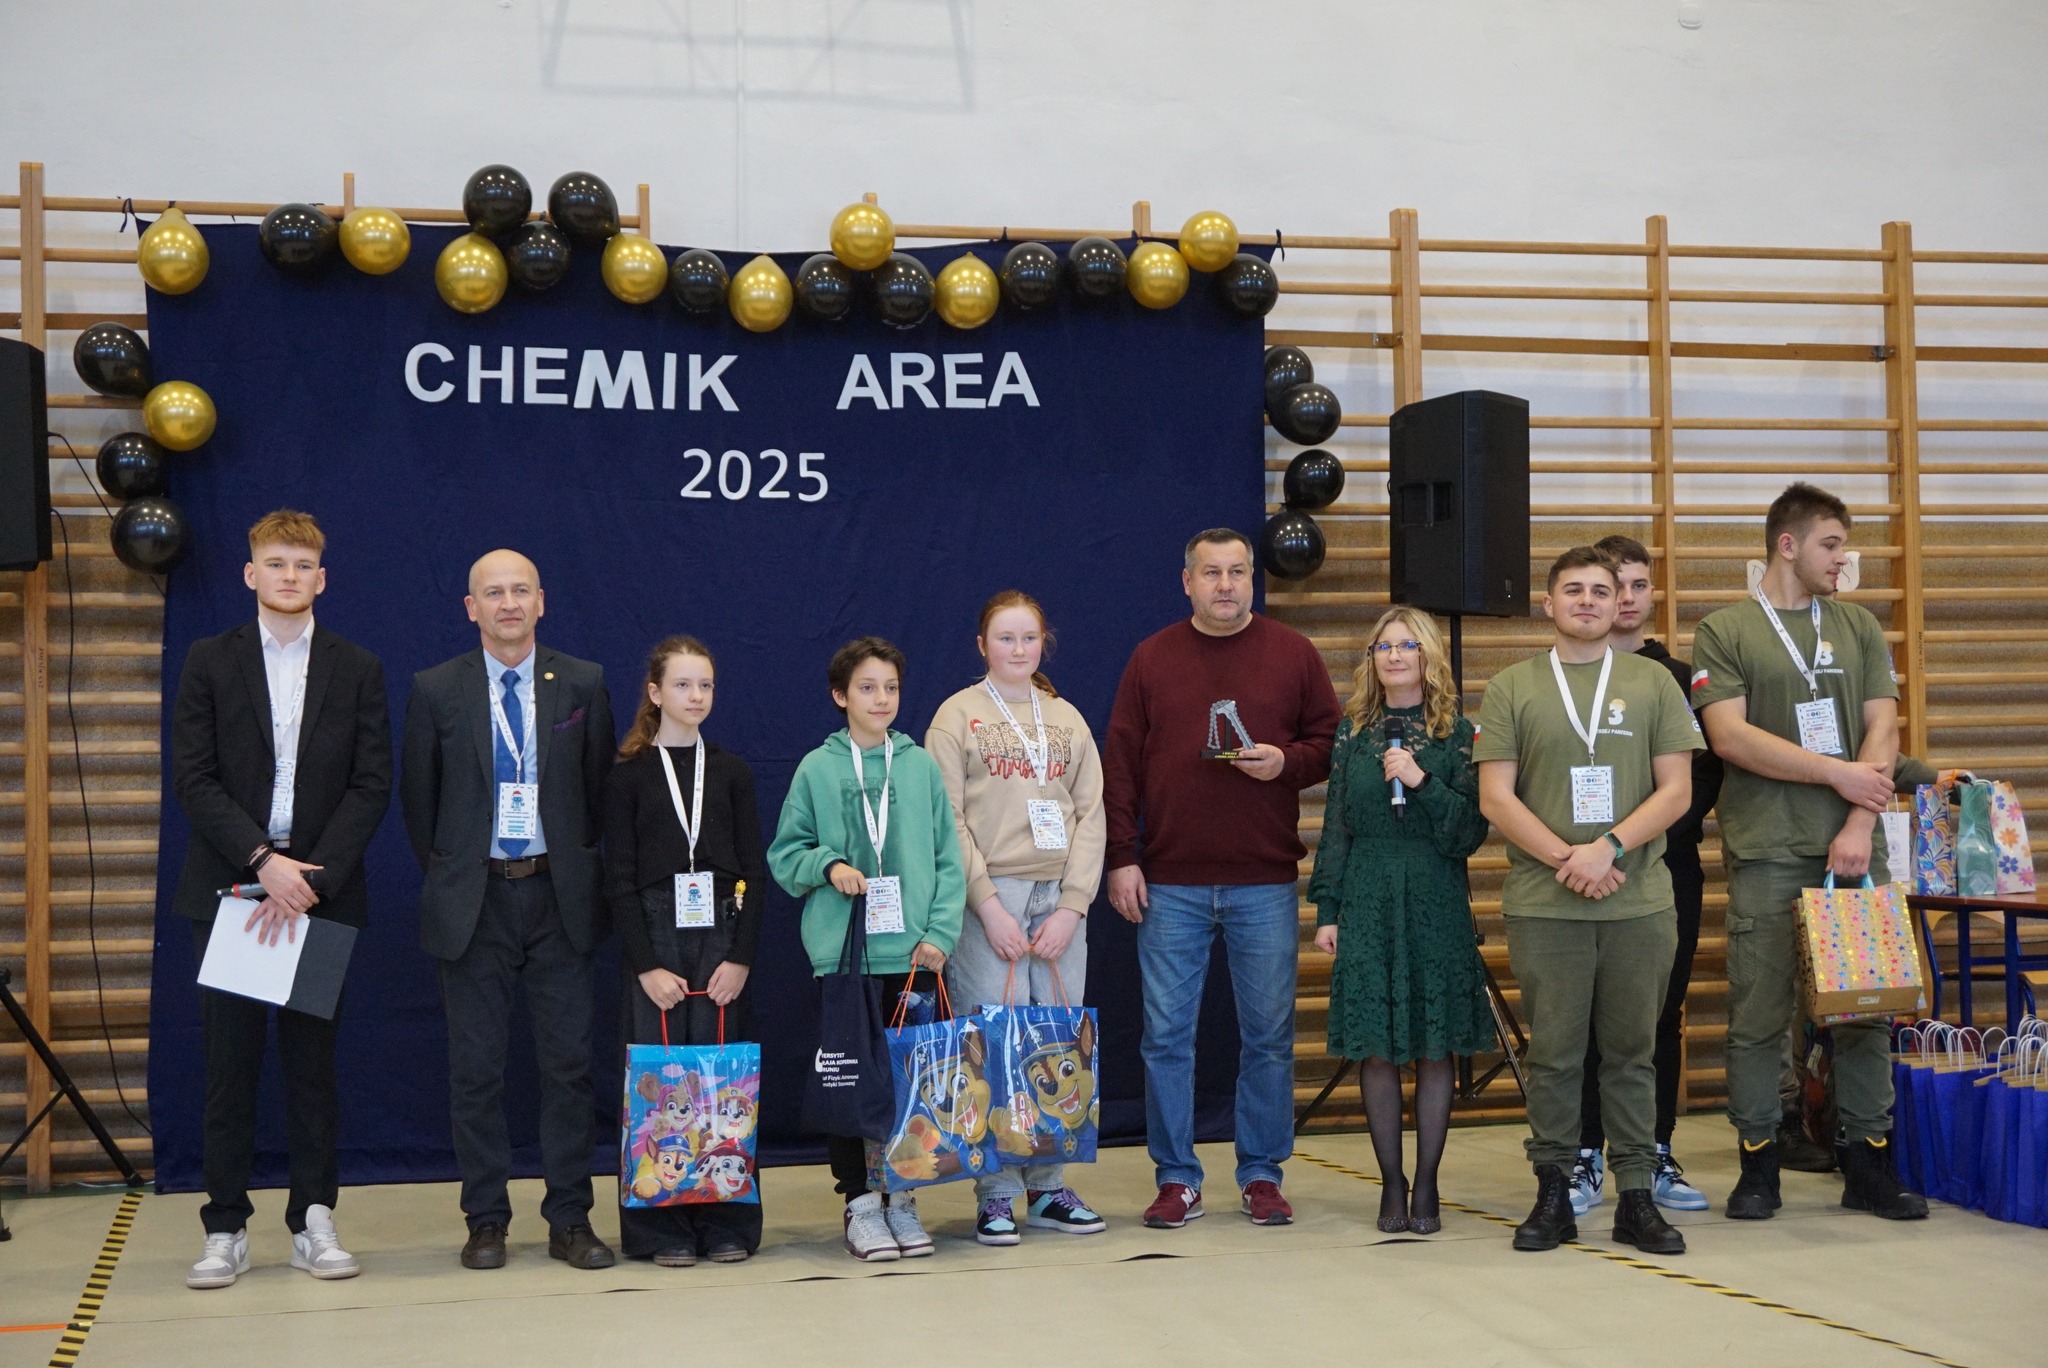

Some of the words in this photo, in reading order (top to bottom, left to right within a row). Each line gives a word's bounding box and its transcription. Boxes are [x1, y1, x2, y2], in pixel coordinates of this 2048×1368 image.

[404, 342, 740, 412] CHEMIK
[836, 351, 1041, 410] AREA
[680, 448, 829, 502] 2025
